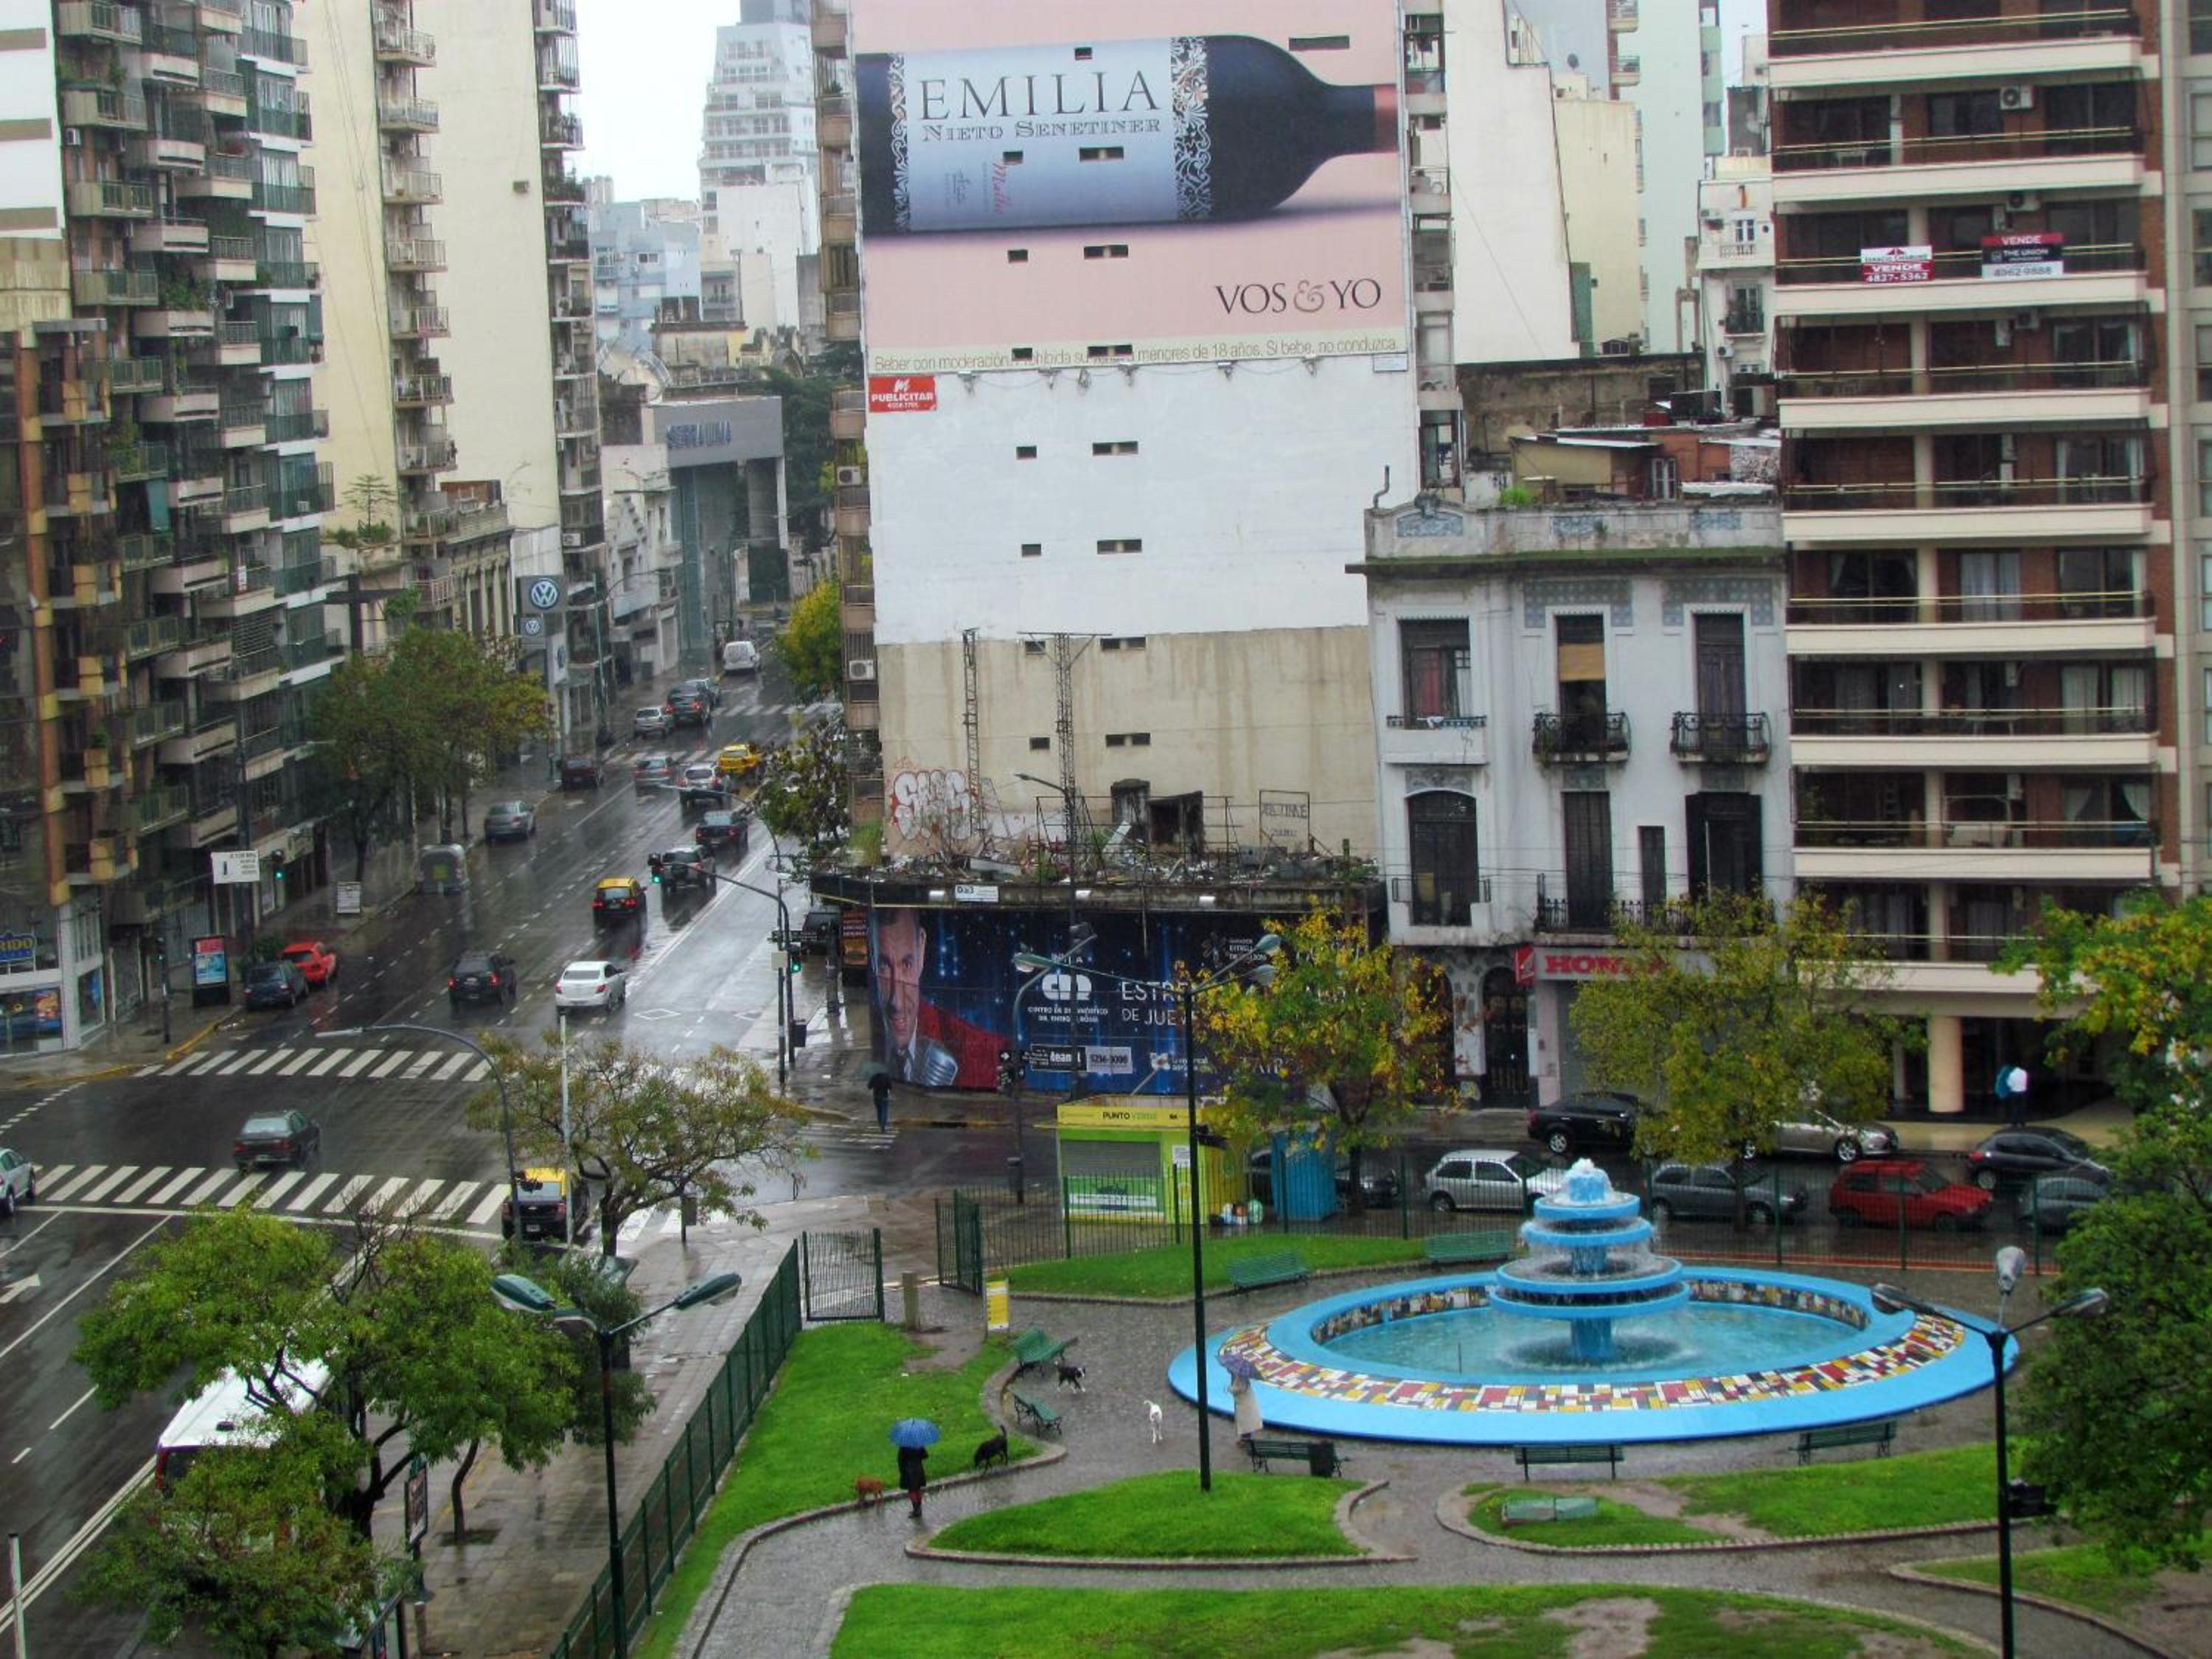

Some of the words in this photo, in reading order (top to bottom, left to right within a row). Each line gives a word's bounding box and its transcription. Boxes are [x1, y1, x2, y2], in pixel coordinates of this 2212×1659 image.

[919, 70, 1161, 121] EMILIA
[922, 125, 1004, 142] NIETO
[1015, 118, 1162, 138] SENETINER
[2001, 235, 2041, 245] VENDE
[1872, 262, 1923, 273] VENDE
[1215, 282, 1287, 314] VOS
[1293, 279, 1324, 313] &
[1329, 278, 1381, 310] YO
[875, 357, 908, 371] Beber
[914, 359, 935, 369] con
[1138, 346, 1190, 361] menores
[1192, 345, 1208, 359] de
[1213, 344, 1228, 358] 18
[1231, 341, 1262, 356] años.
[1266, 341, 1278, 355] Si
[1319, 342, 1336, 352] no
[871, 392, 933, 401] PUBLICITAR
[1121, 1009, 1140, 1021] DE
[1102, 1111, 1130, 1120] PUNTO
